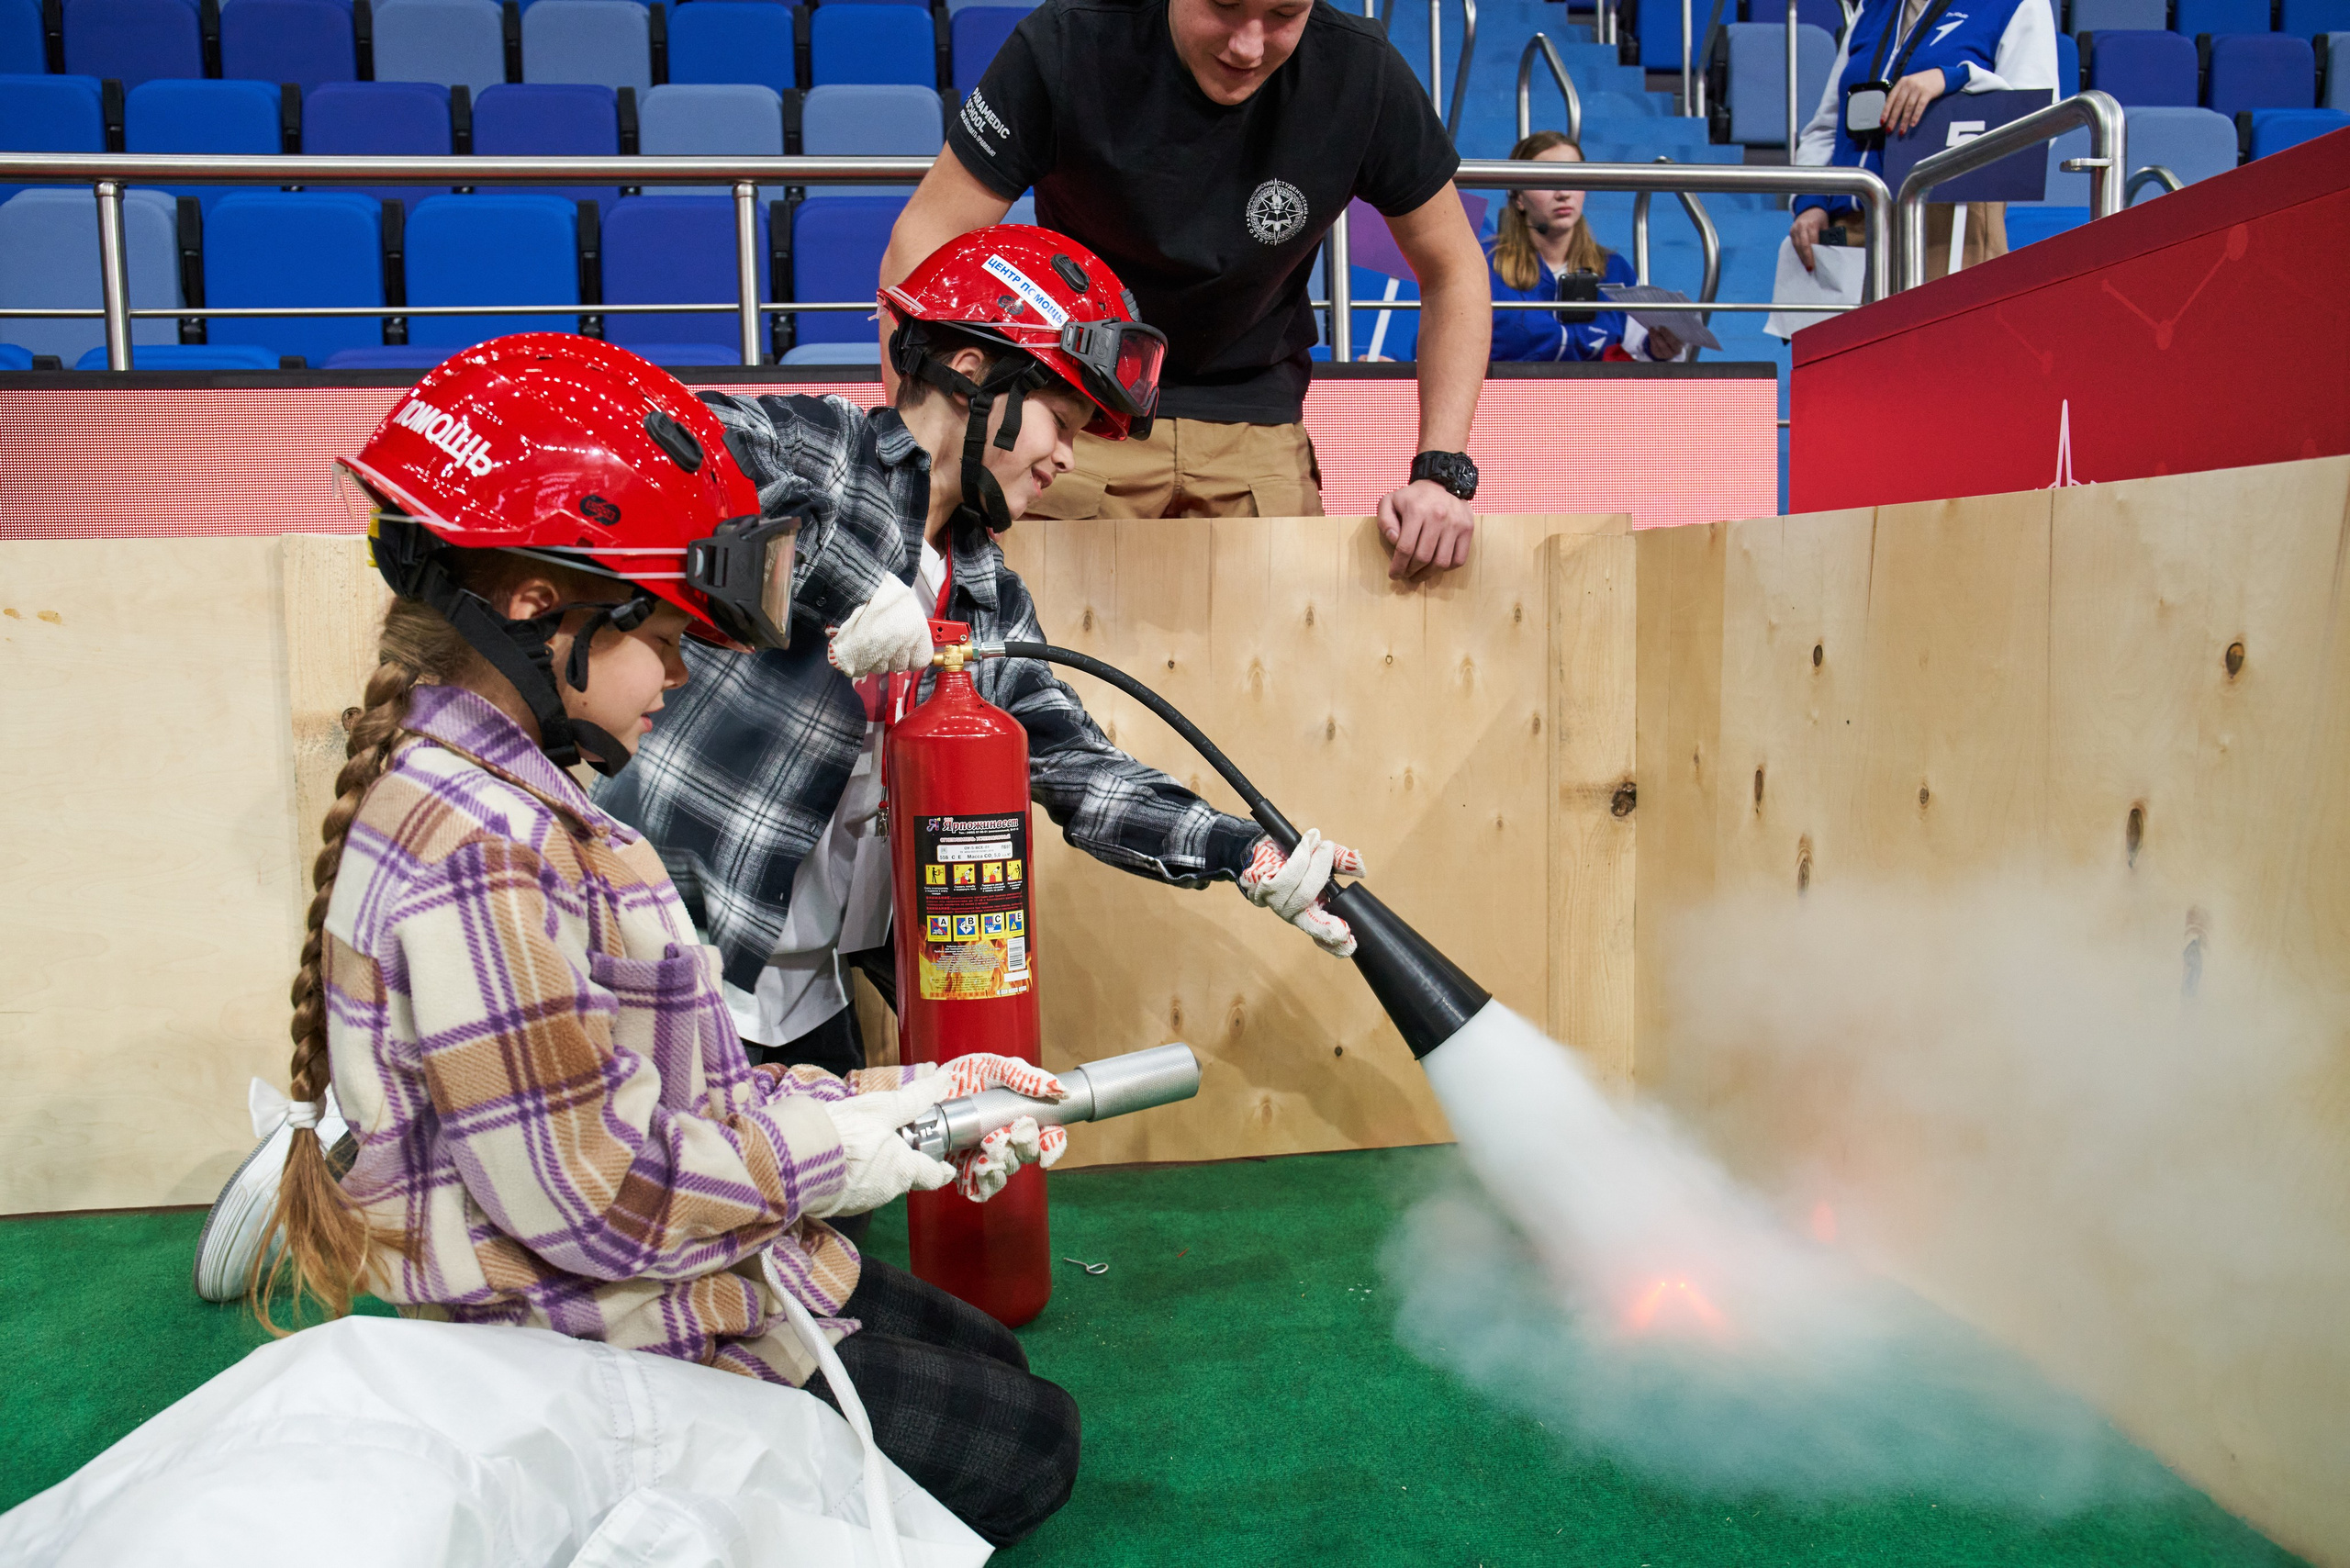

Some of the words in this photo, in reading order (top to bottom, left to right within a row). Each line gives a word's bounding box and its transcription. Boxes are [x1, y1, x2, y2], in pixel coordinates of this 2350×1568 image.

[966, 97, 986, 133] SCHOOL
[972, 86, 1010, 139] PARAMEDIC
[1277, 180, 1309, 214] СТУДЕНЧЕСКИЙ
[1247, 223, 1274, 245] КОРПУС
[988, 258, 1022, 282] ЦЕНТР
[1020, 282, 1063, 324] ПОМОЩЬ
[392, 398, 493, 476] ПОМОЩЬ
[942, 818, 1019, 834] Ярпожинвест
[994, 915, 1001, 924] C
